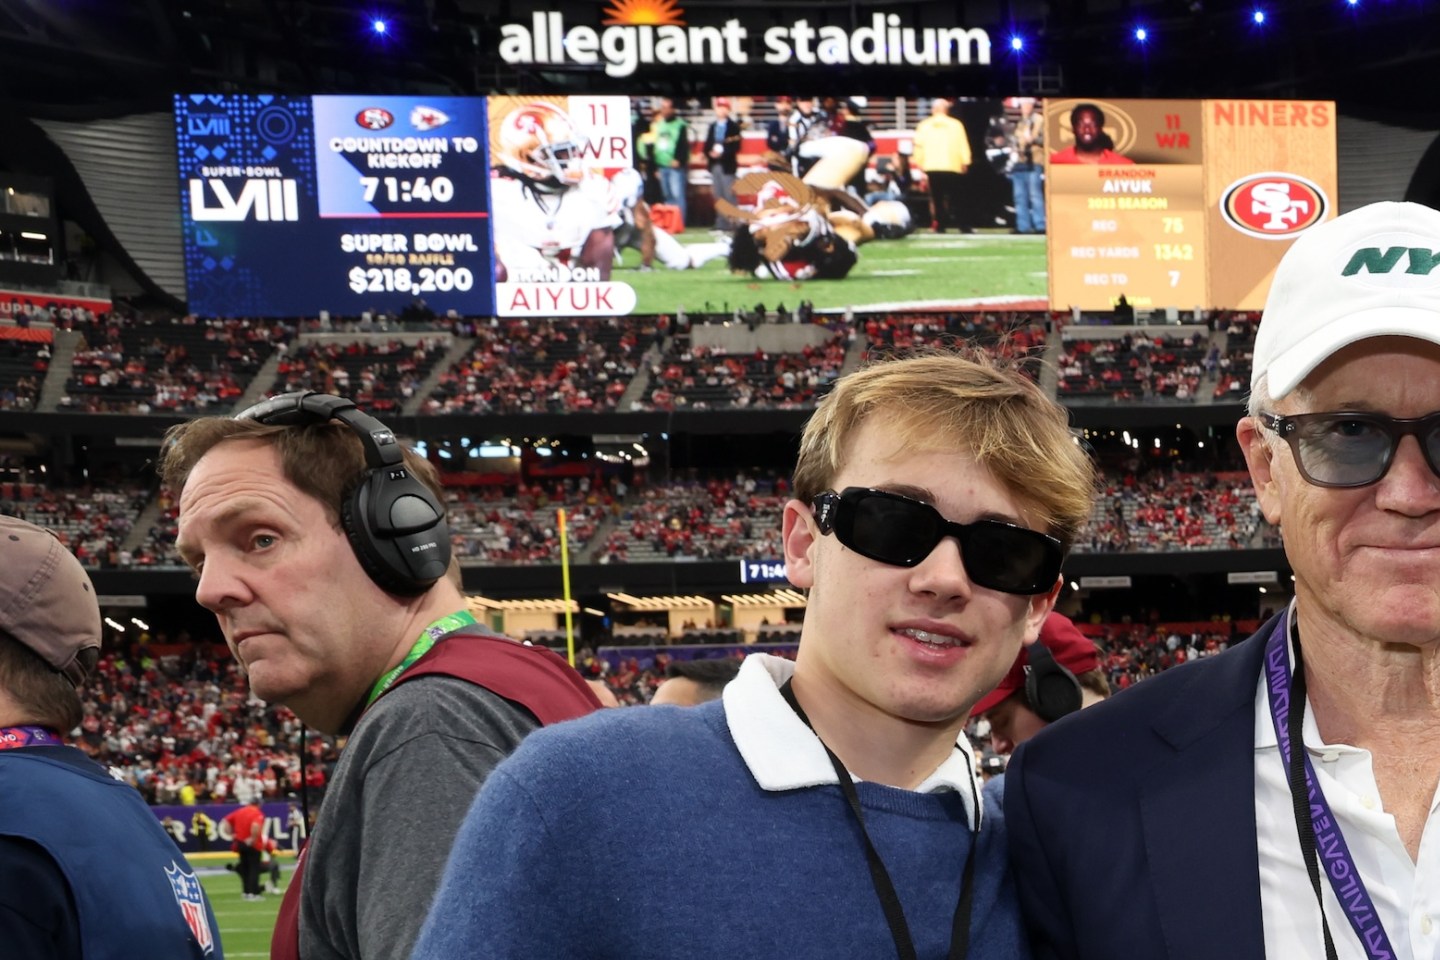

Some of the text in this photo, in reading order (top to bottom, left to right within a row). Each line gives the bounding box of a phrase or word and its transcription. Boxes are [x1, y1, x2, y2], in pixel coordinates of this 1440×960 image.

[499, 11, 991, 77] allegiant stadium
[588, 104, 608, 125] 11
[1165, 115, 1181, 130] 11
[1214, 102, 1329, 127] NINERS
[329, 137, 478, 153] COUNTDOWN TO
[1156, 133, 1190, 149] WR
[367, 153, 442, 168] KICKOFF
[202, 166, 282, 177] SUPER BOWL
[1098, 169, 1155, 178] BRANDON
[359, 176, 454, 202] 71:40
[1103, 180, 1151, 193] AIYUK
[189, 178, 299, 222] LVIII
[1118, 198, 1168, 210] SEASON
[1162, 217, 1184, 234] 75
[340, 234, 478, 253] SUPER BOWL
[1154, 244, 1193, 261] 1342
[349, 266, 473, 296] $218,200
[1168, 271, 1181, 288] 7
[510, 287, 614, 311] AIYUK
